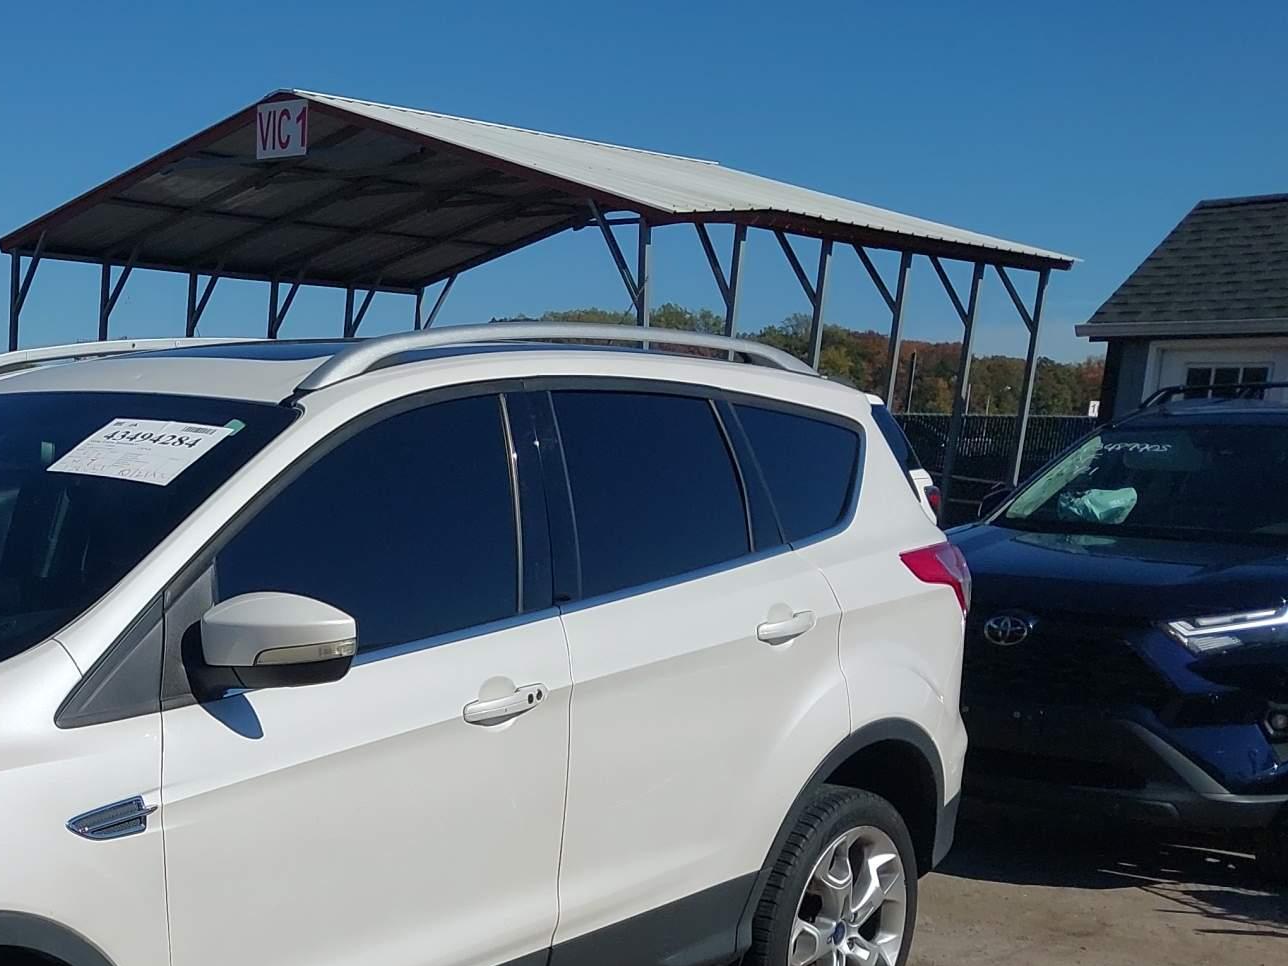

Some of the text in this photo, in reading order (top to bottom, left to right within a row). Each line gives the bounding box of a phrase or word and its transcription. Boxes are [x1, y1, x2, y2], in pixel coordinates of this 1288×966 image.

[258, 106, 307, 151] VIC 1
[104, 430, 203, 448] 43494284
